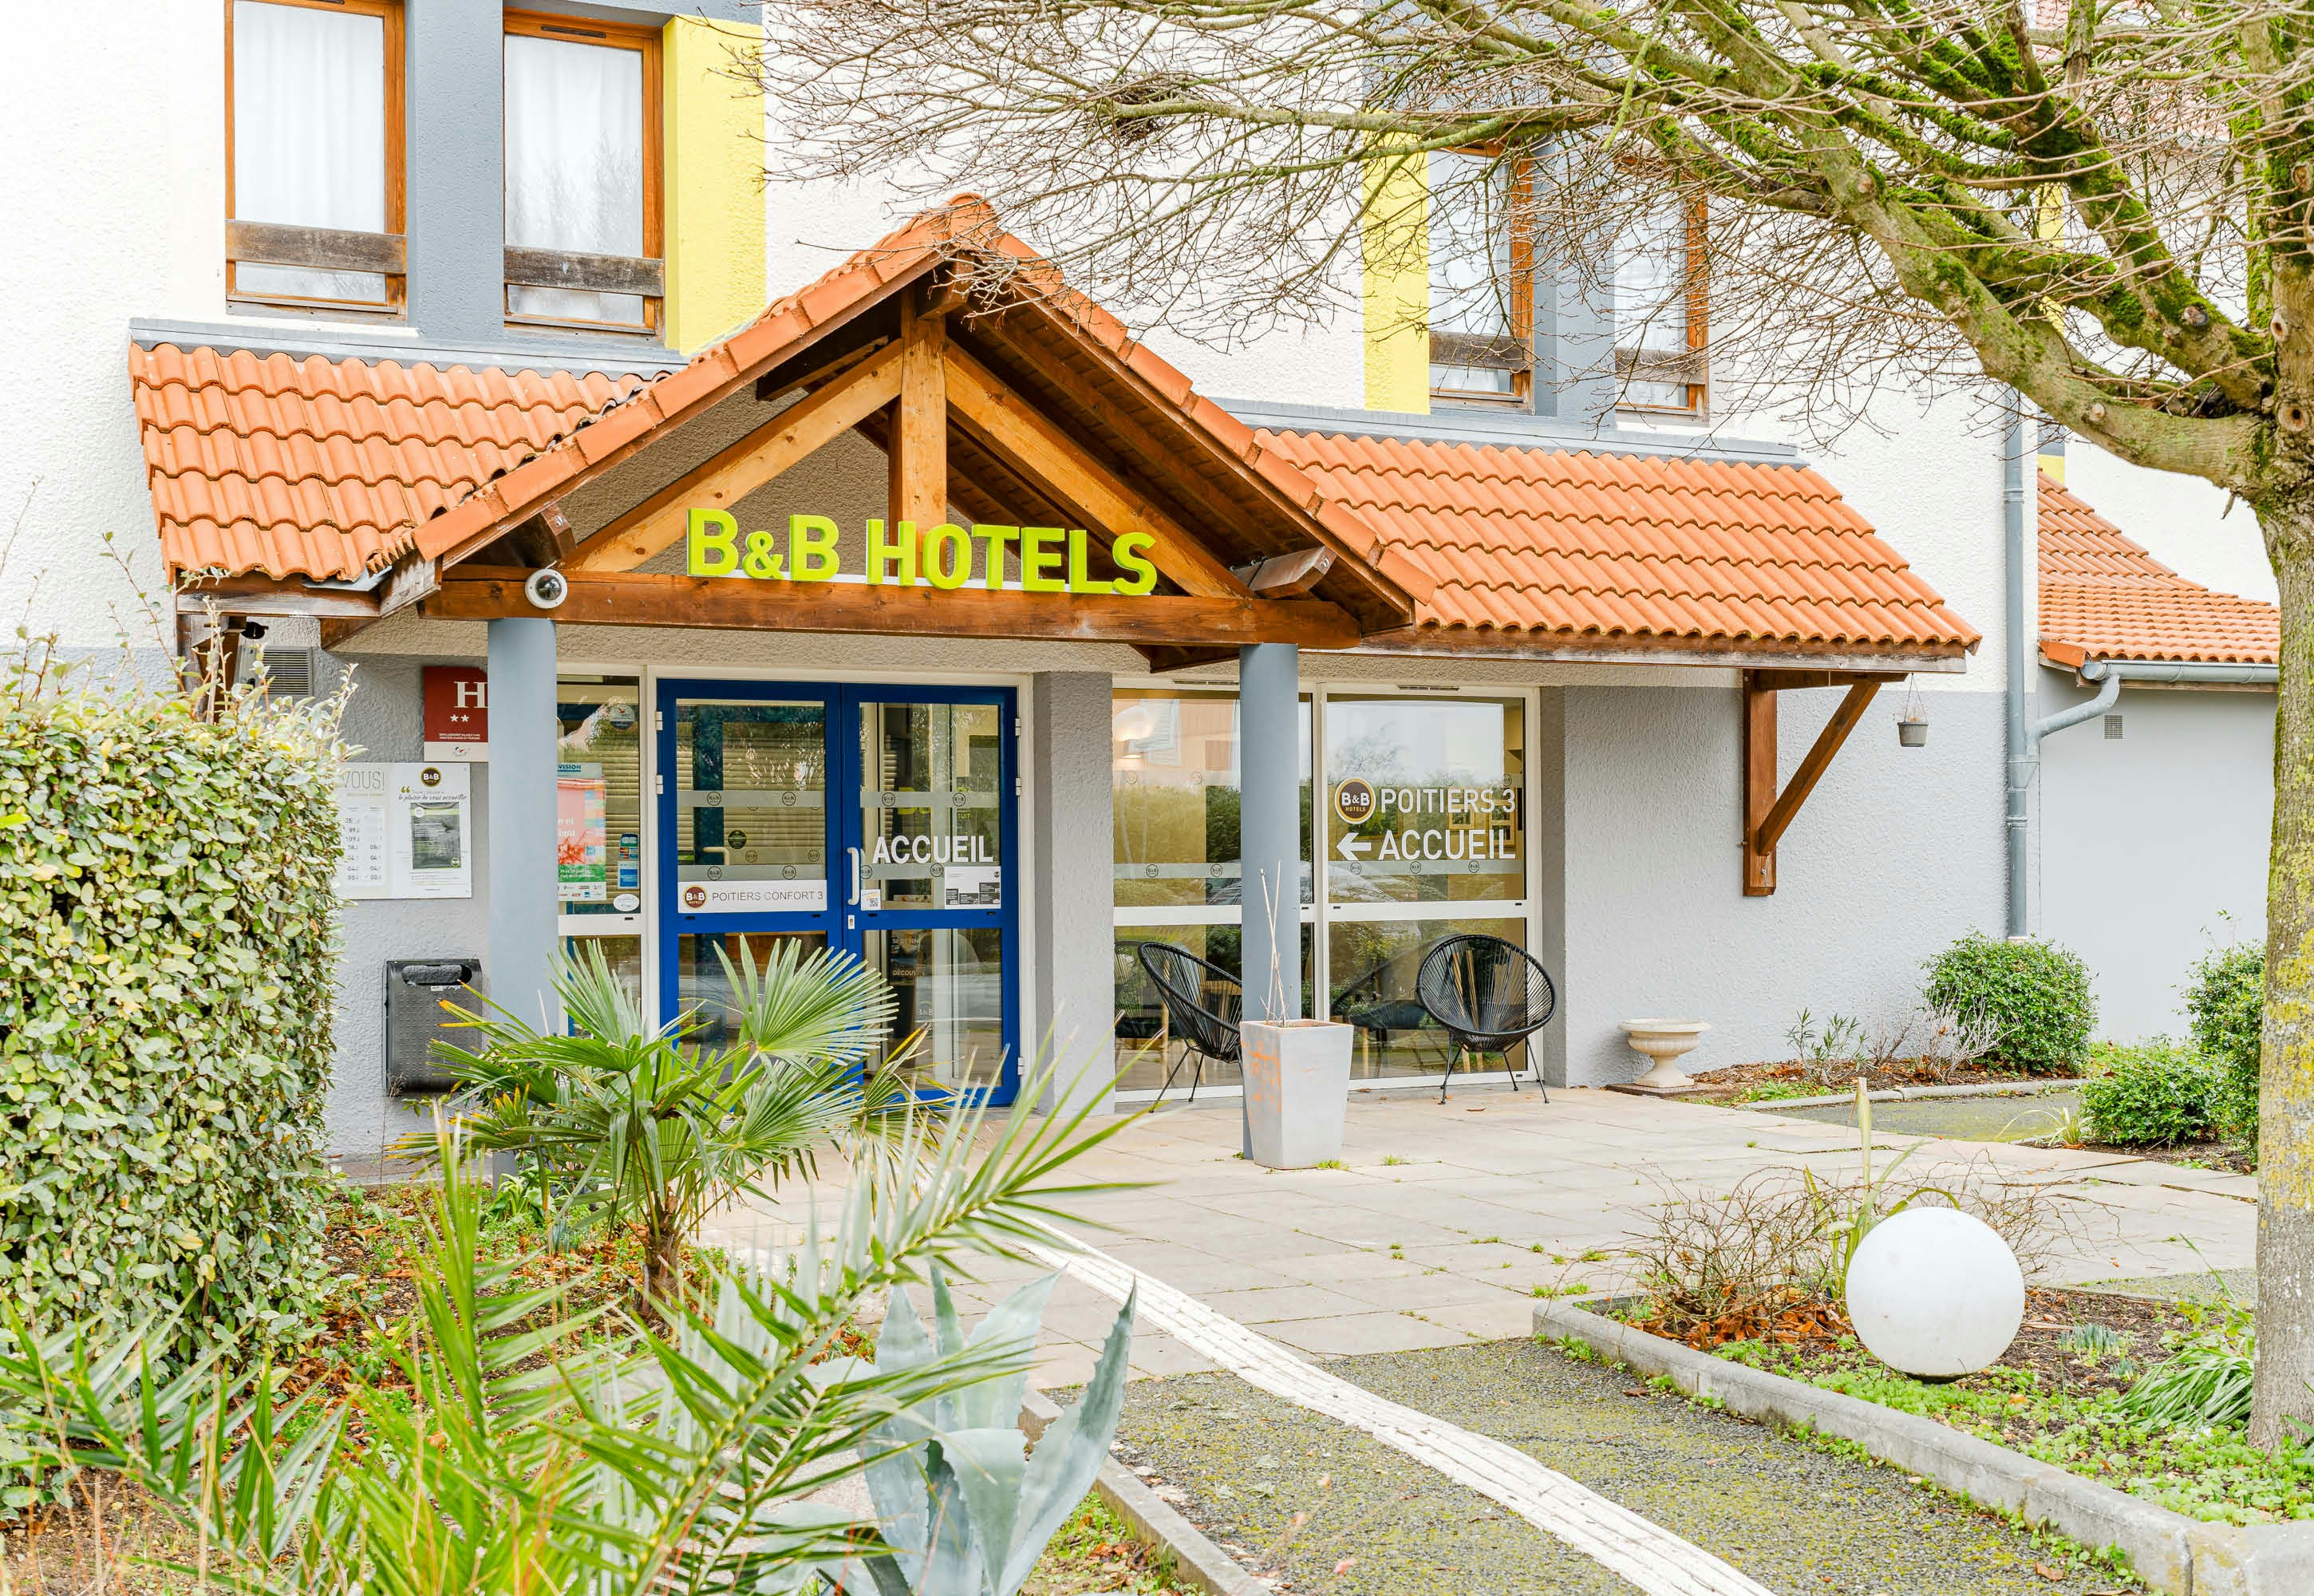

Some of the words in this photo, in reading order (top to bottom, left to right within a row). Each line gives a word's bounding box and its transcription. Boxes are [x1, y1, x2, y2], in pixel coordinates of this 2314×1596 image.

[687, 508, 840, 583] B&B
[866, 518, 1158, 596] HOTELS
[453, 681, 488, 709] H
[1341, 792, 1369, 806] B&B
[1381, 788, 1495, 813] POITIERS
[1503, 788, 1515, 813] 3
[872, 835, 994, 863] ACCUEIL
[1379, 829, 1516, 860] ACCUEIL
[686, 892, 705, 901] B&B
[712, 891, 761, 901] POITIERS
[764, 891, 815, 900] CONFORT
[817, 891, 823, 900] 3
